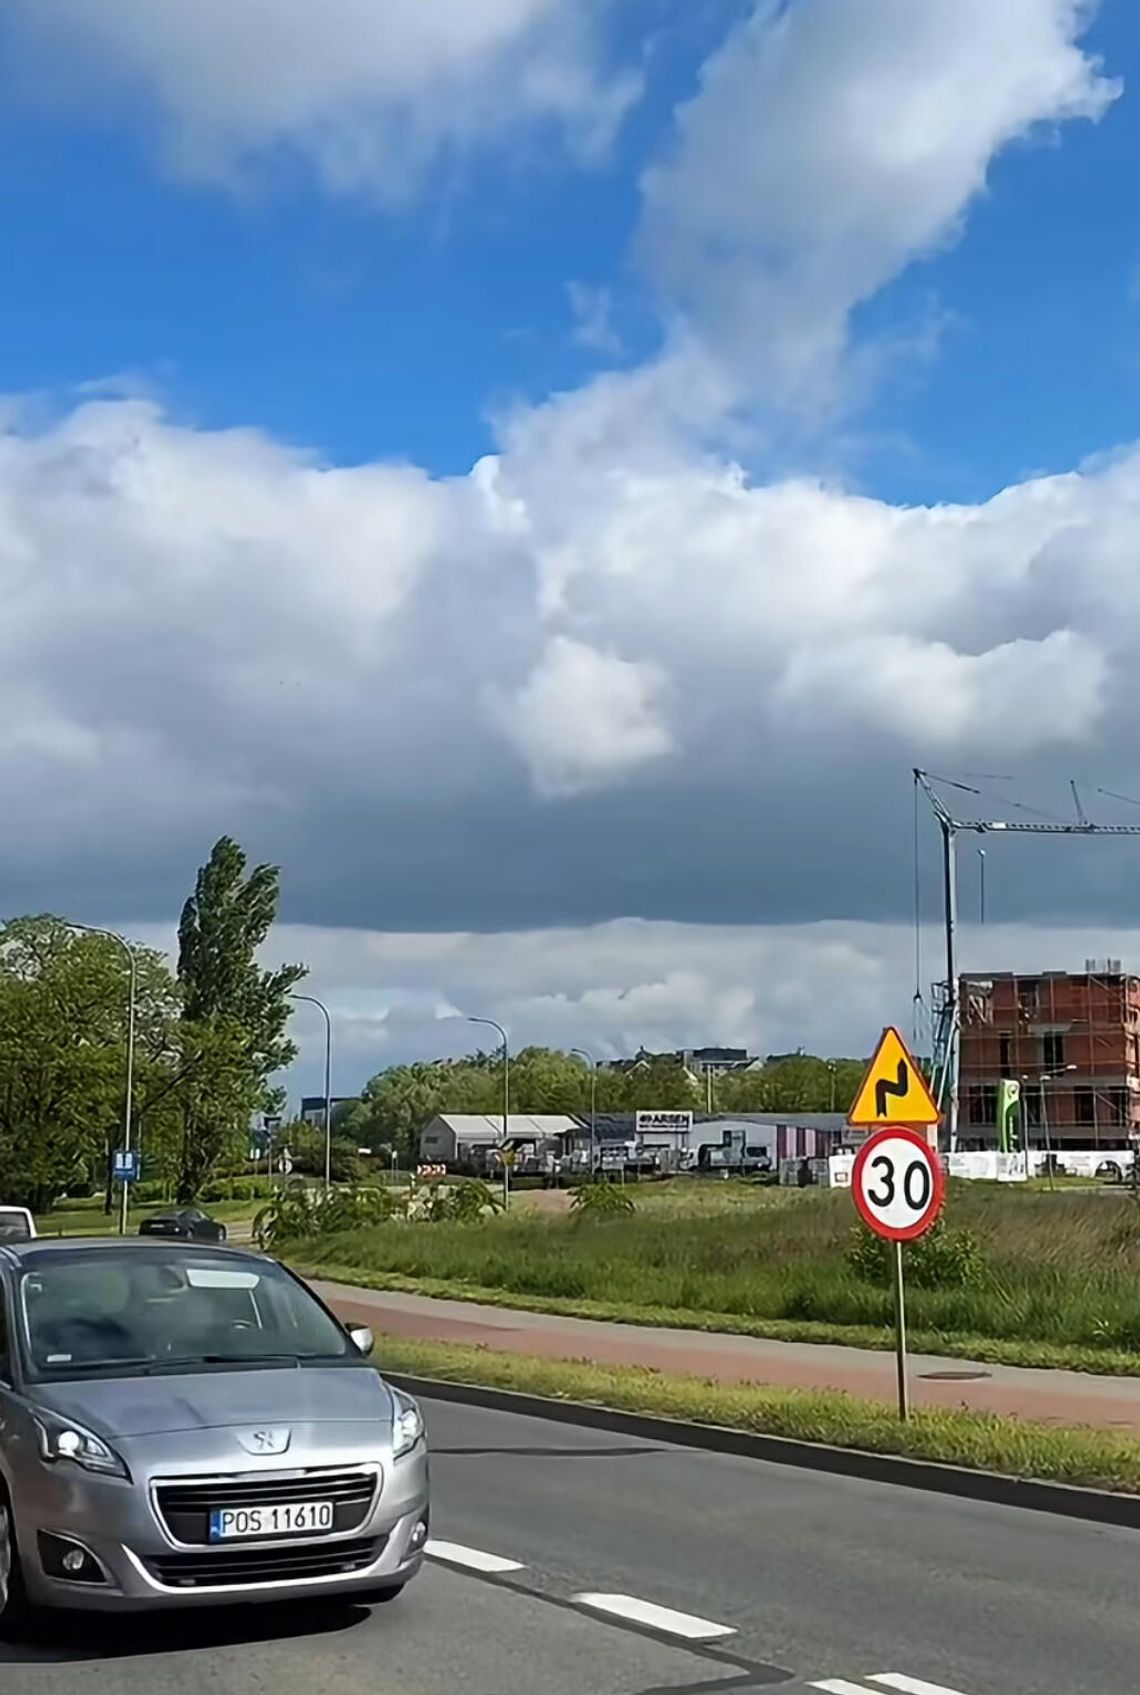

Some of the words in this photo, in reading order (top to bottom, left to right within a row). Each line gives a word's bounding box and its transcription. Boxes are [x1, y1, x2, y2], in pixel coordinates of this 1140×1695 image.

[868, 1155, 930, 1211] 30
[222, 1509, 262, 1534] POS
[272, 1504, 331, 1530] 11610
